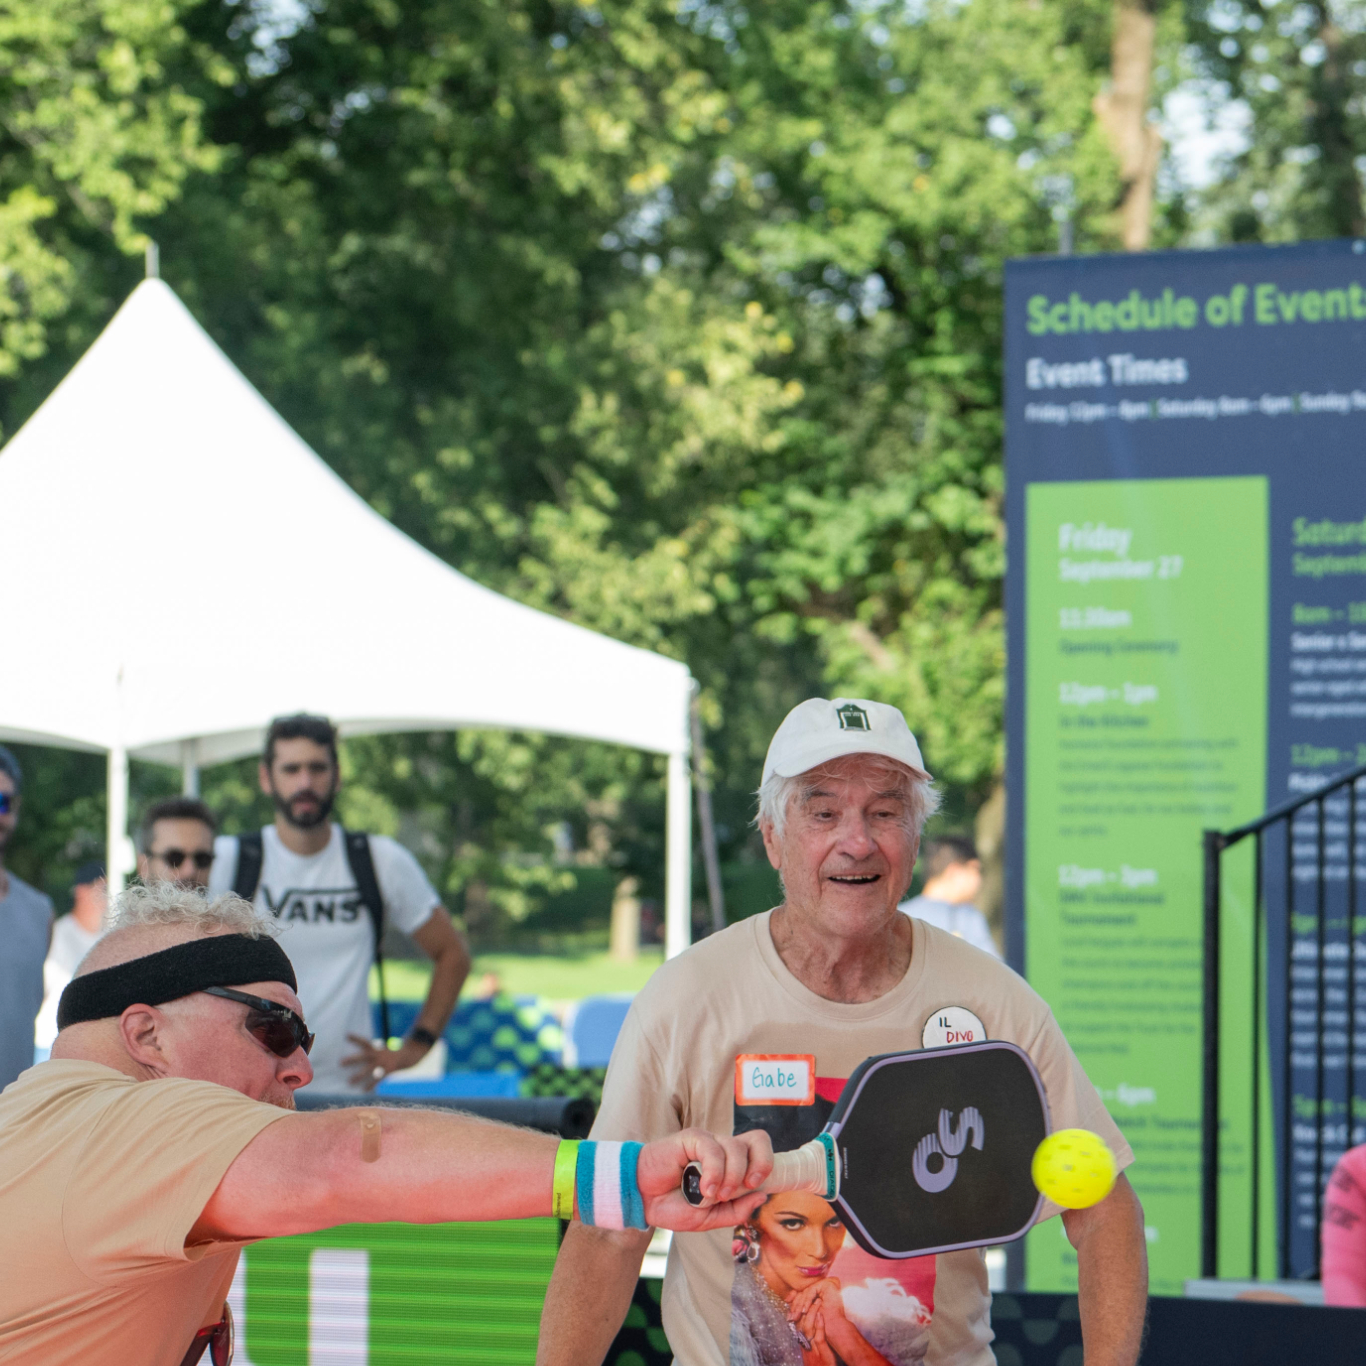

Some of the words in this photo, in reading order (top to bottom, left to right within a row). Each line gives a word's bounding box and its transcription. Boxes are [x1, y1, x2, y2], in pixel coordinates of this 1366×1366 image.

[1027, 288, 1198, 334] Schedule
[1205, 283, 1247, 326] of
[1025, 357, 1106, 390] Event
[1108, 353, 1189, 384] Times
[1058, 521, 1134, 558] Friday
[1058, 557, 1155, 585] September
[260, 886, 362, 923] VANS
[751, 1066, 797, 1089] Gabe
